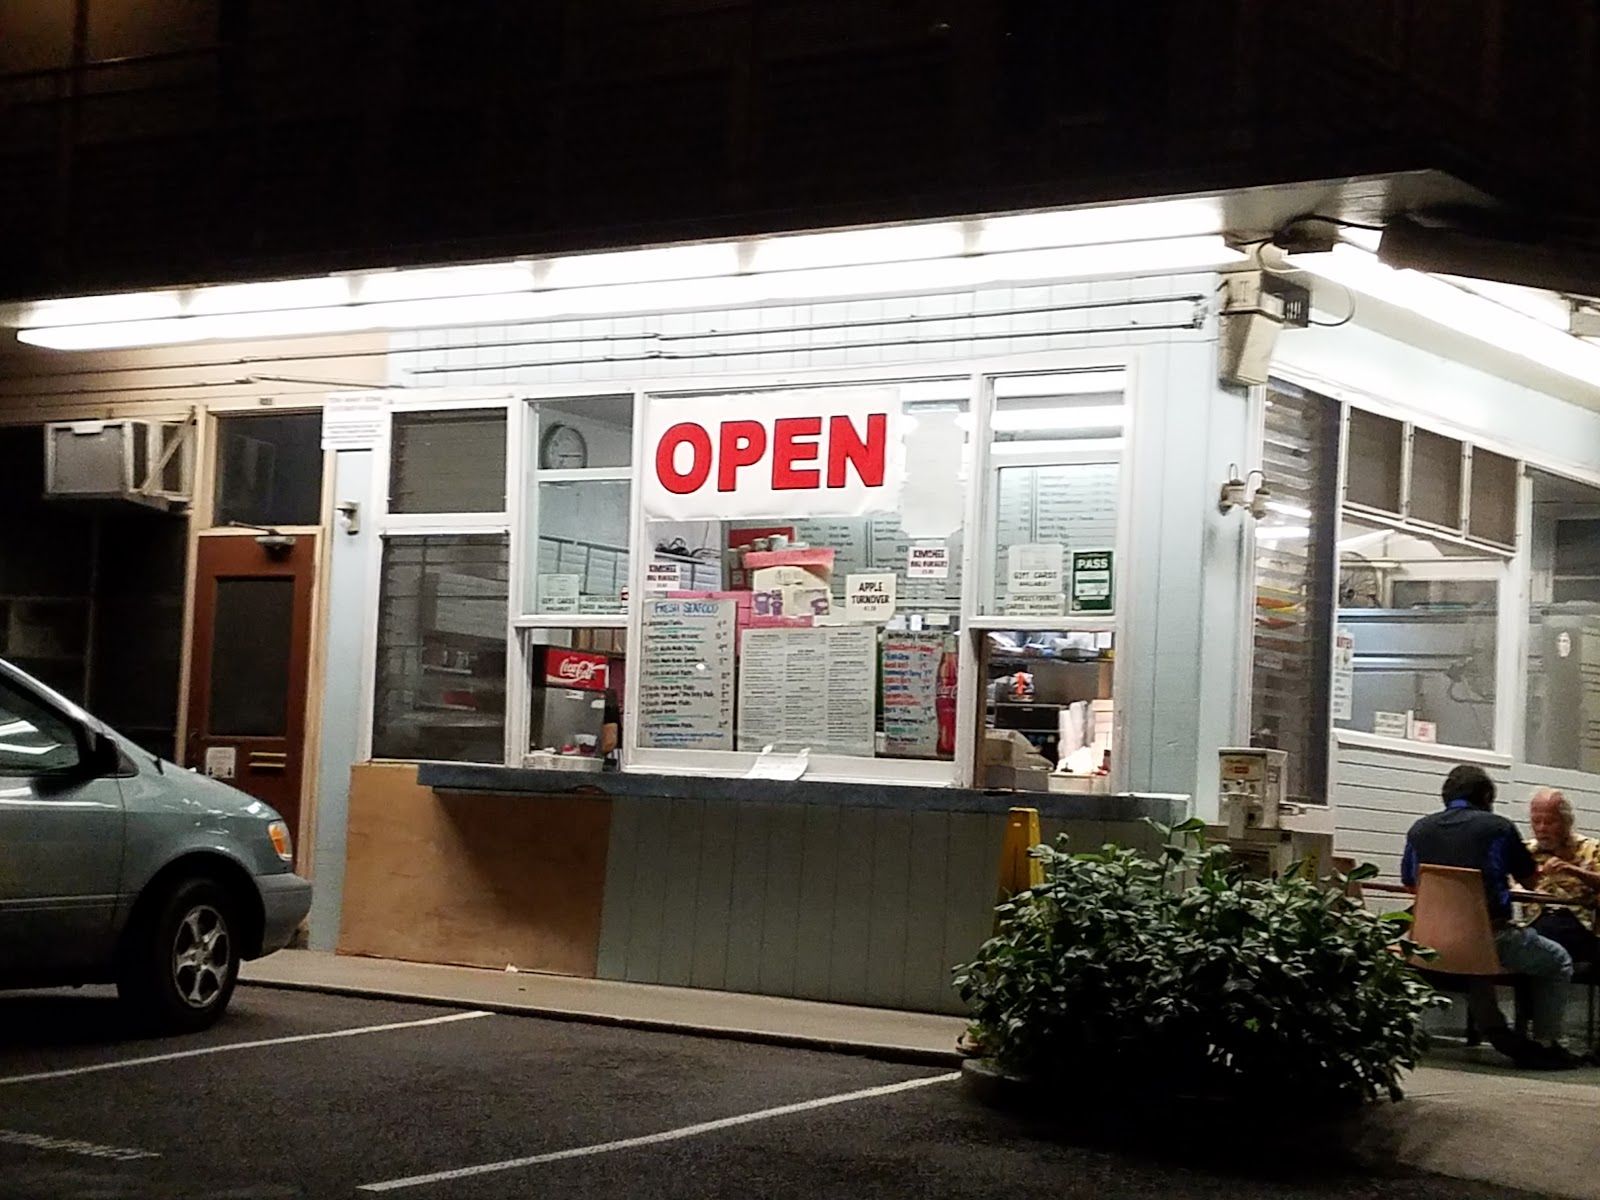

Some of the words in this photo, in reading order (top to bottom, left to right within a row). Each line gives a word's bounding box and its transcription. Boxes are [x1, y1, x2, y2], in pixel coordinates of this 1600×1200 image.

[655, 413, 887, 494] OPEN
[1078, 559, 1108, 569] PASS
[858, 582, 883, 592] APPLE
[851, 595, 890, 604] TURNOVER
[655, 602, 680, 613] FRESH
[682, 602, 719, 614] SEAFOOD
